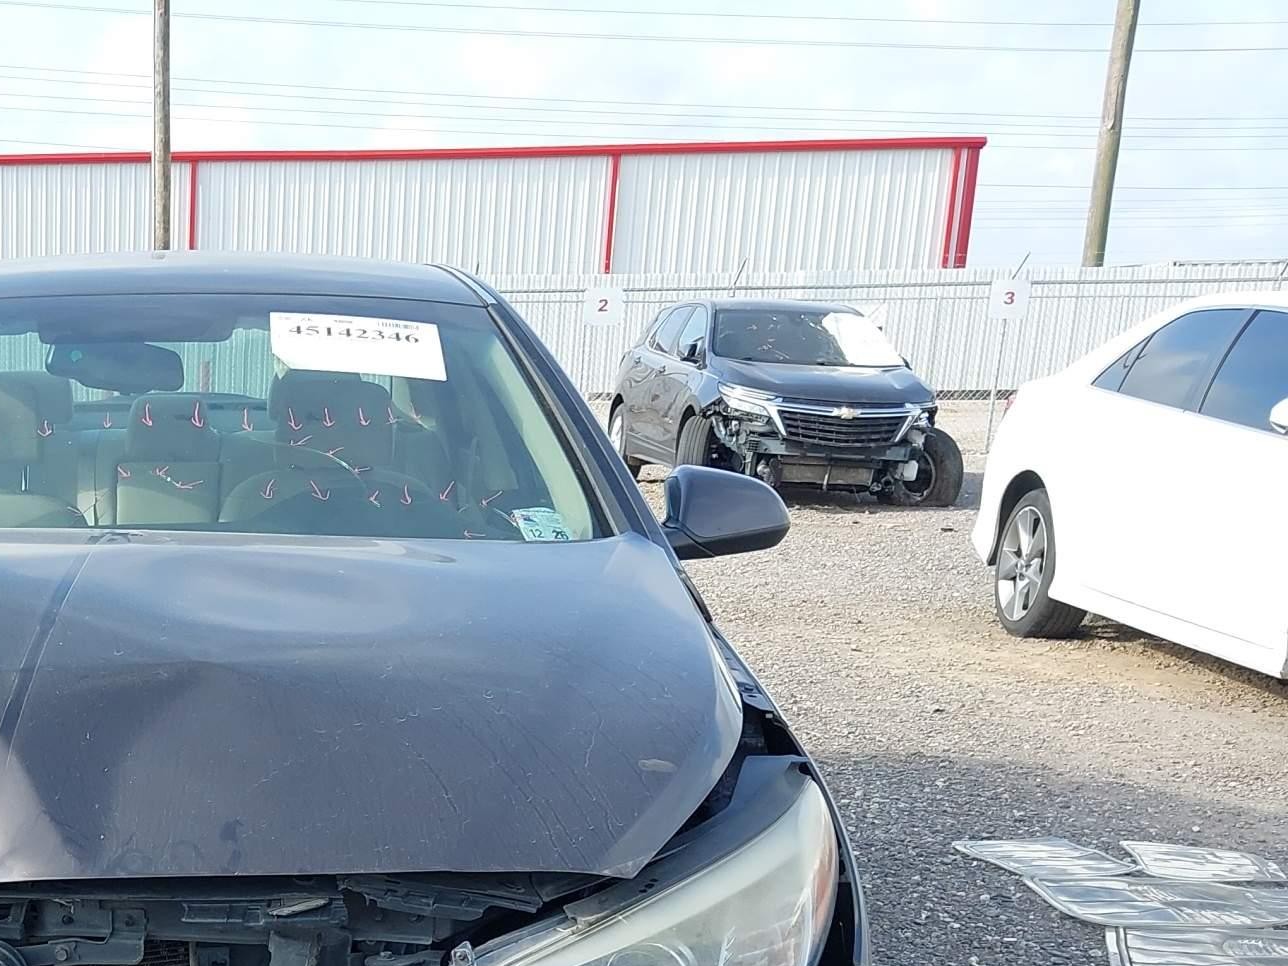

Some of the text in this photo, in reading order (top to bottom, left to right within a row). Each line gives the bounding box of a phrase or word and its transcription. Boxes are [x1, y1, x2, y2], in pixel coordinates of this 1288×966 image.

[1003, 291, 1015, 305] 3
[598, 299, 608, 312] 2
[289, 325, 420, 344] 45142346
[529, 528, 544, 539] 12
